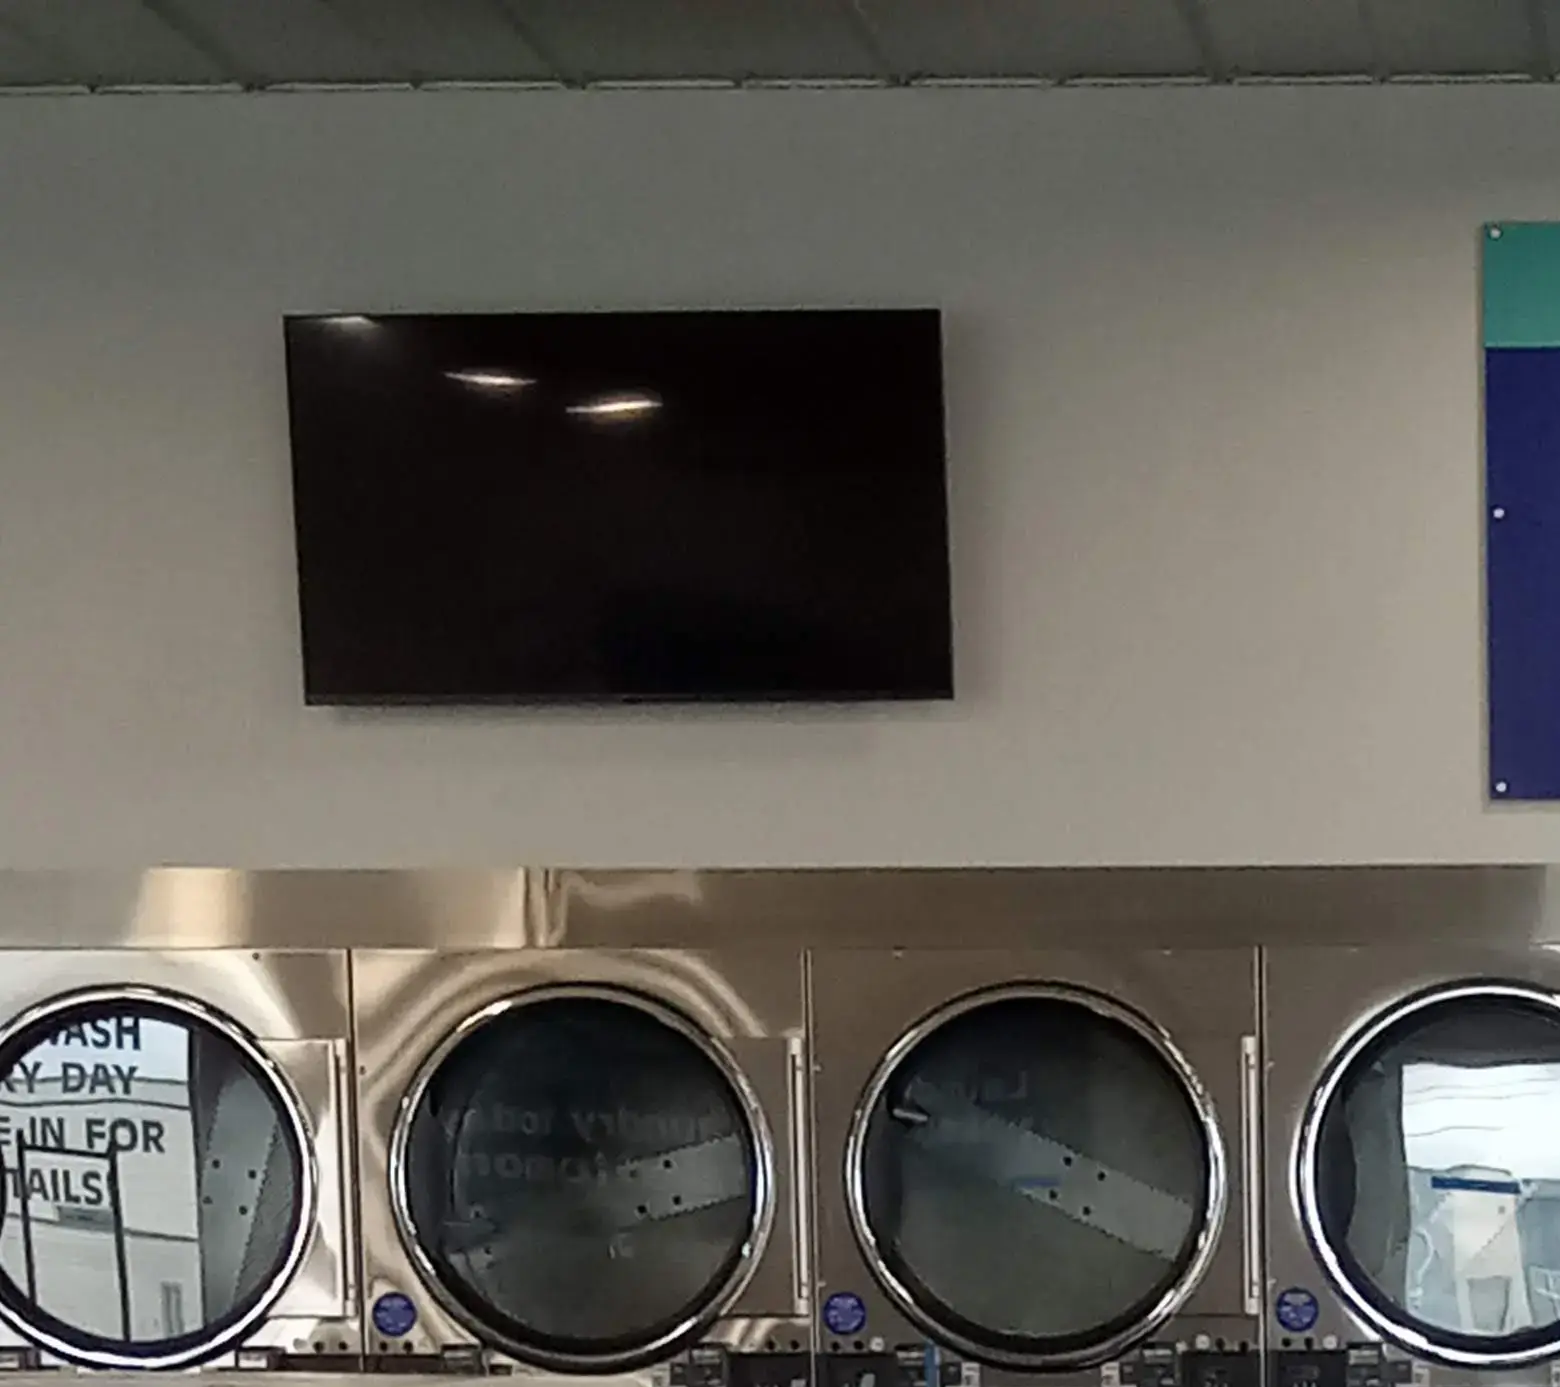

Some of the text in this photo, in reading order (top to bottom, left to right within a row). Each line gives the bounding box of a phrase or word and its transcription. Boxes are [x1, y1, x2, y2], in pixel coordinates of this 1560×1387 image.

[48, 1016, 141, 1050] ASH
[61, 1061, 138, 1095] DAY
[29, 1116, 66, 1149] IN
[85, 1117, 165, 1153] FOR
